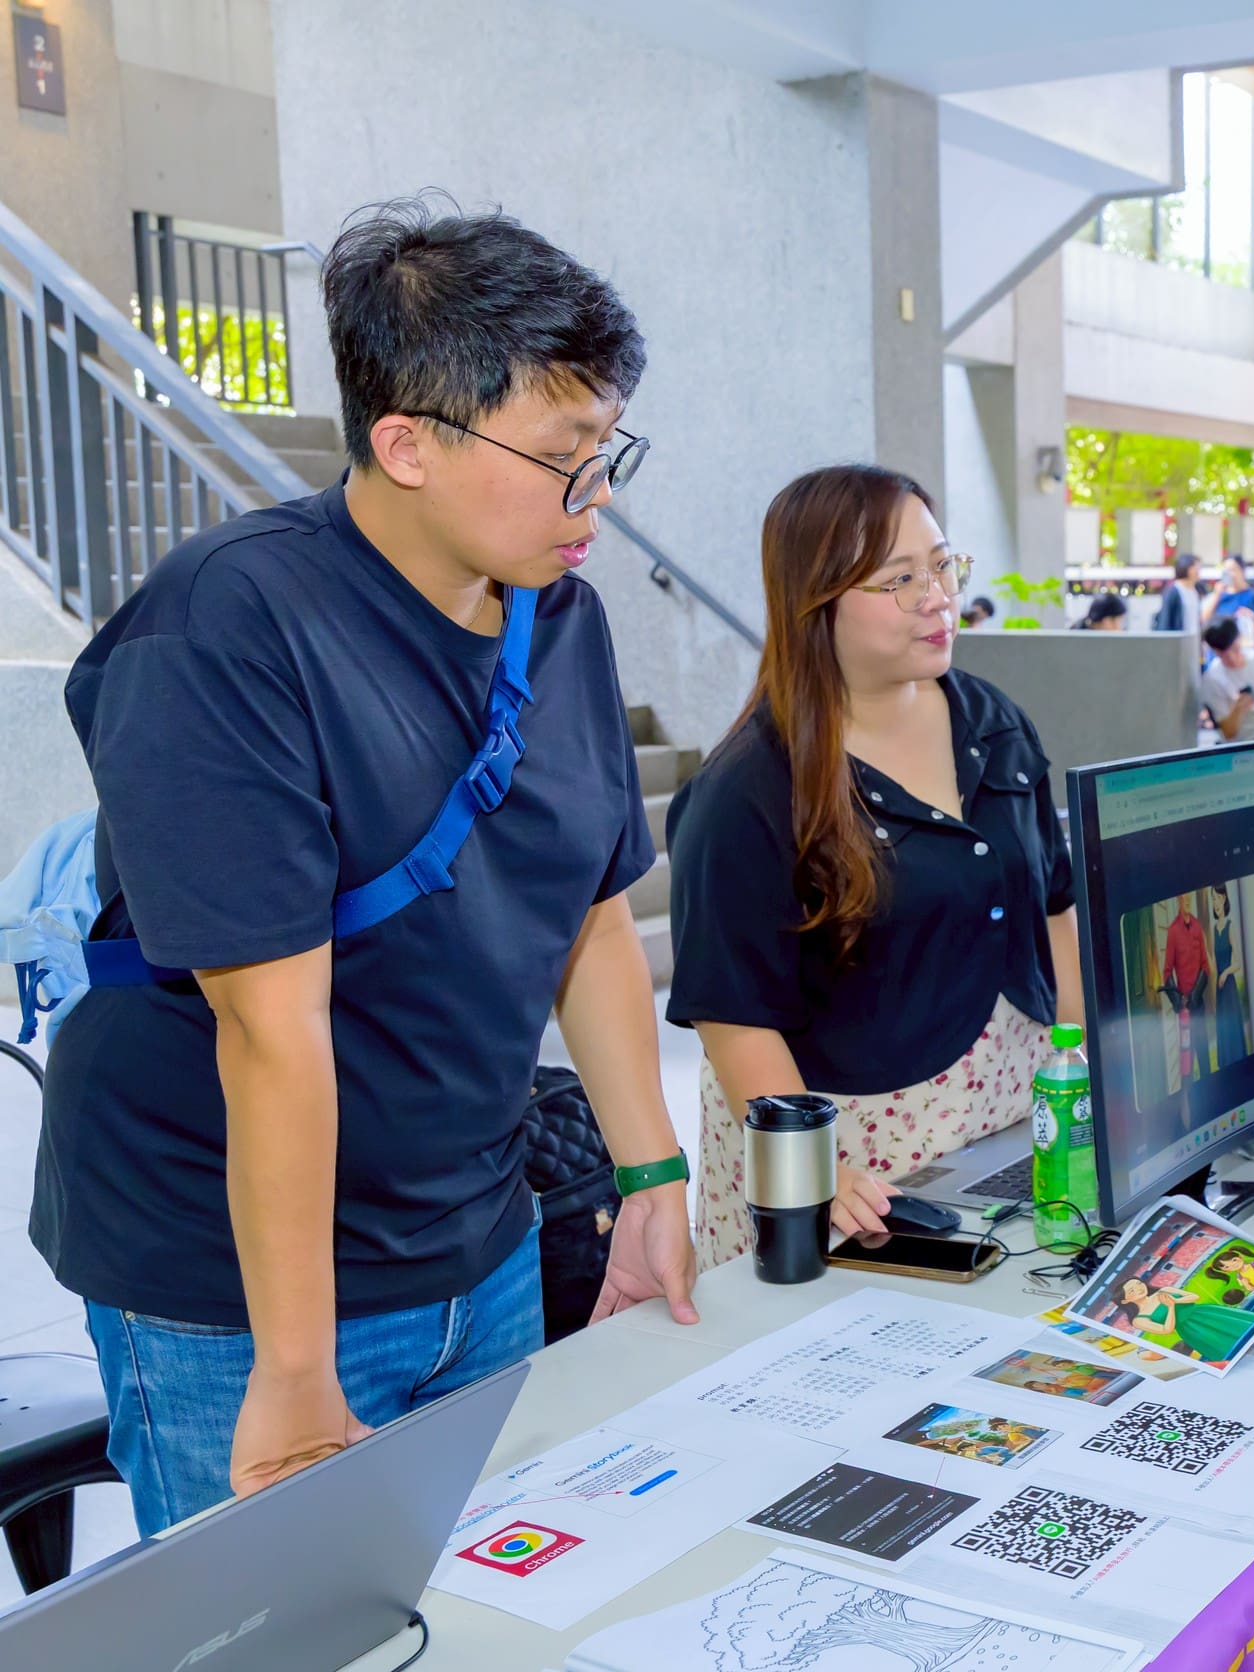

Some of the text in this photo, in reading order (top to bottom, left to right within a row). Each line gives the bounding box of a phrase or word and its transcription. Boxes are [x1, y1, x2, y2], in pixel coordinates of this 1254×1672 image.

[515, 1460, 544, 1477] Gemini
[554, 1468, 590, 1487] Gemini
[586, 1441, 636, 1471] Storybook
[524, 1540, 576, 1571] Chrome
[173, 1607, 271, 1672] ASUS
